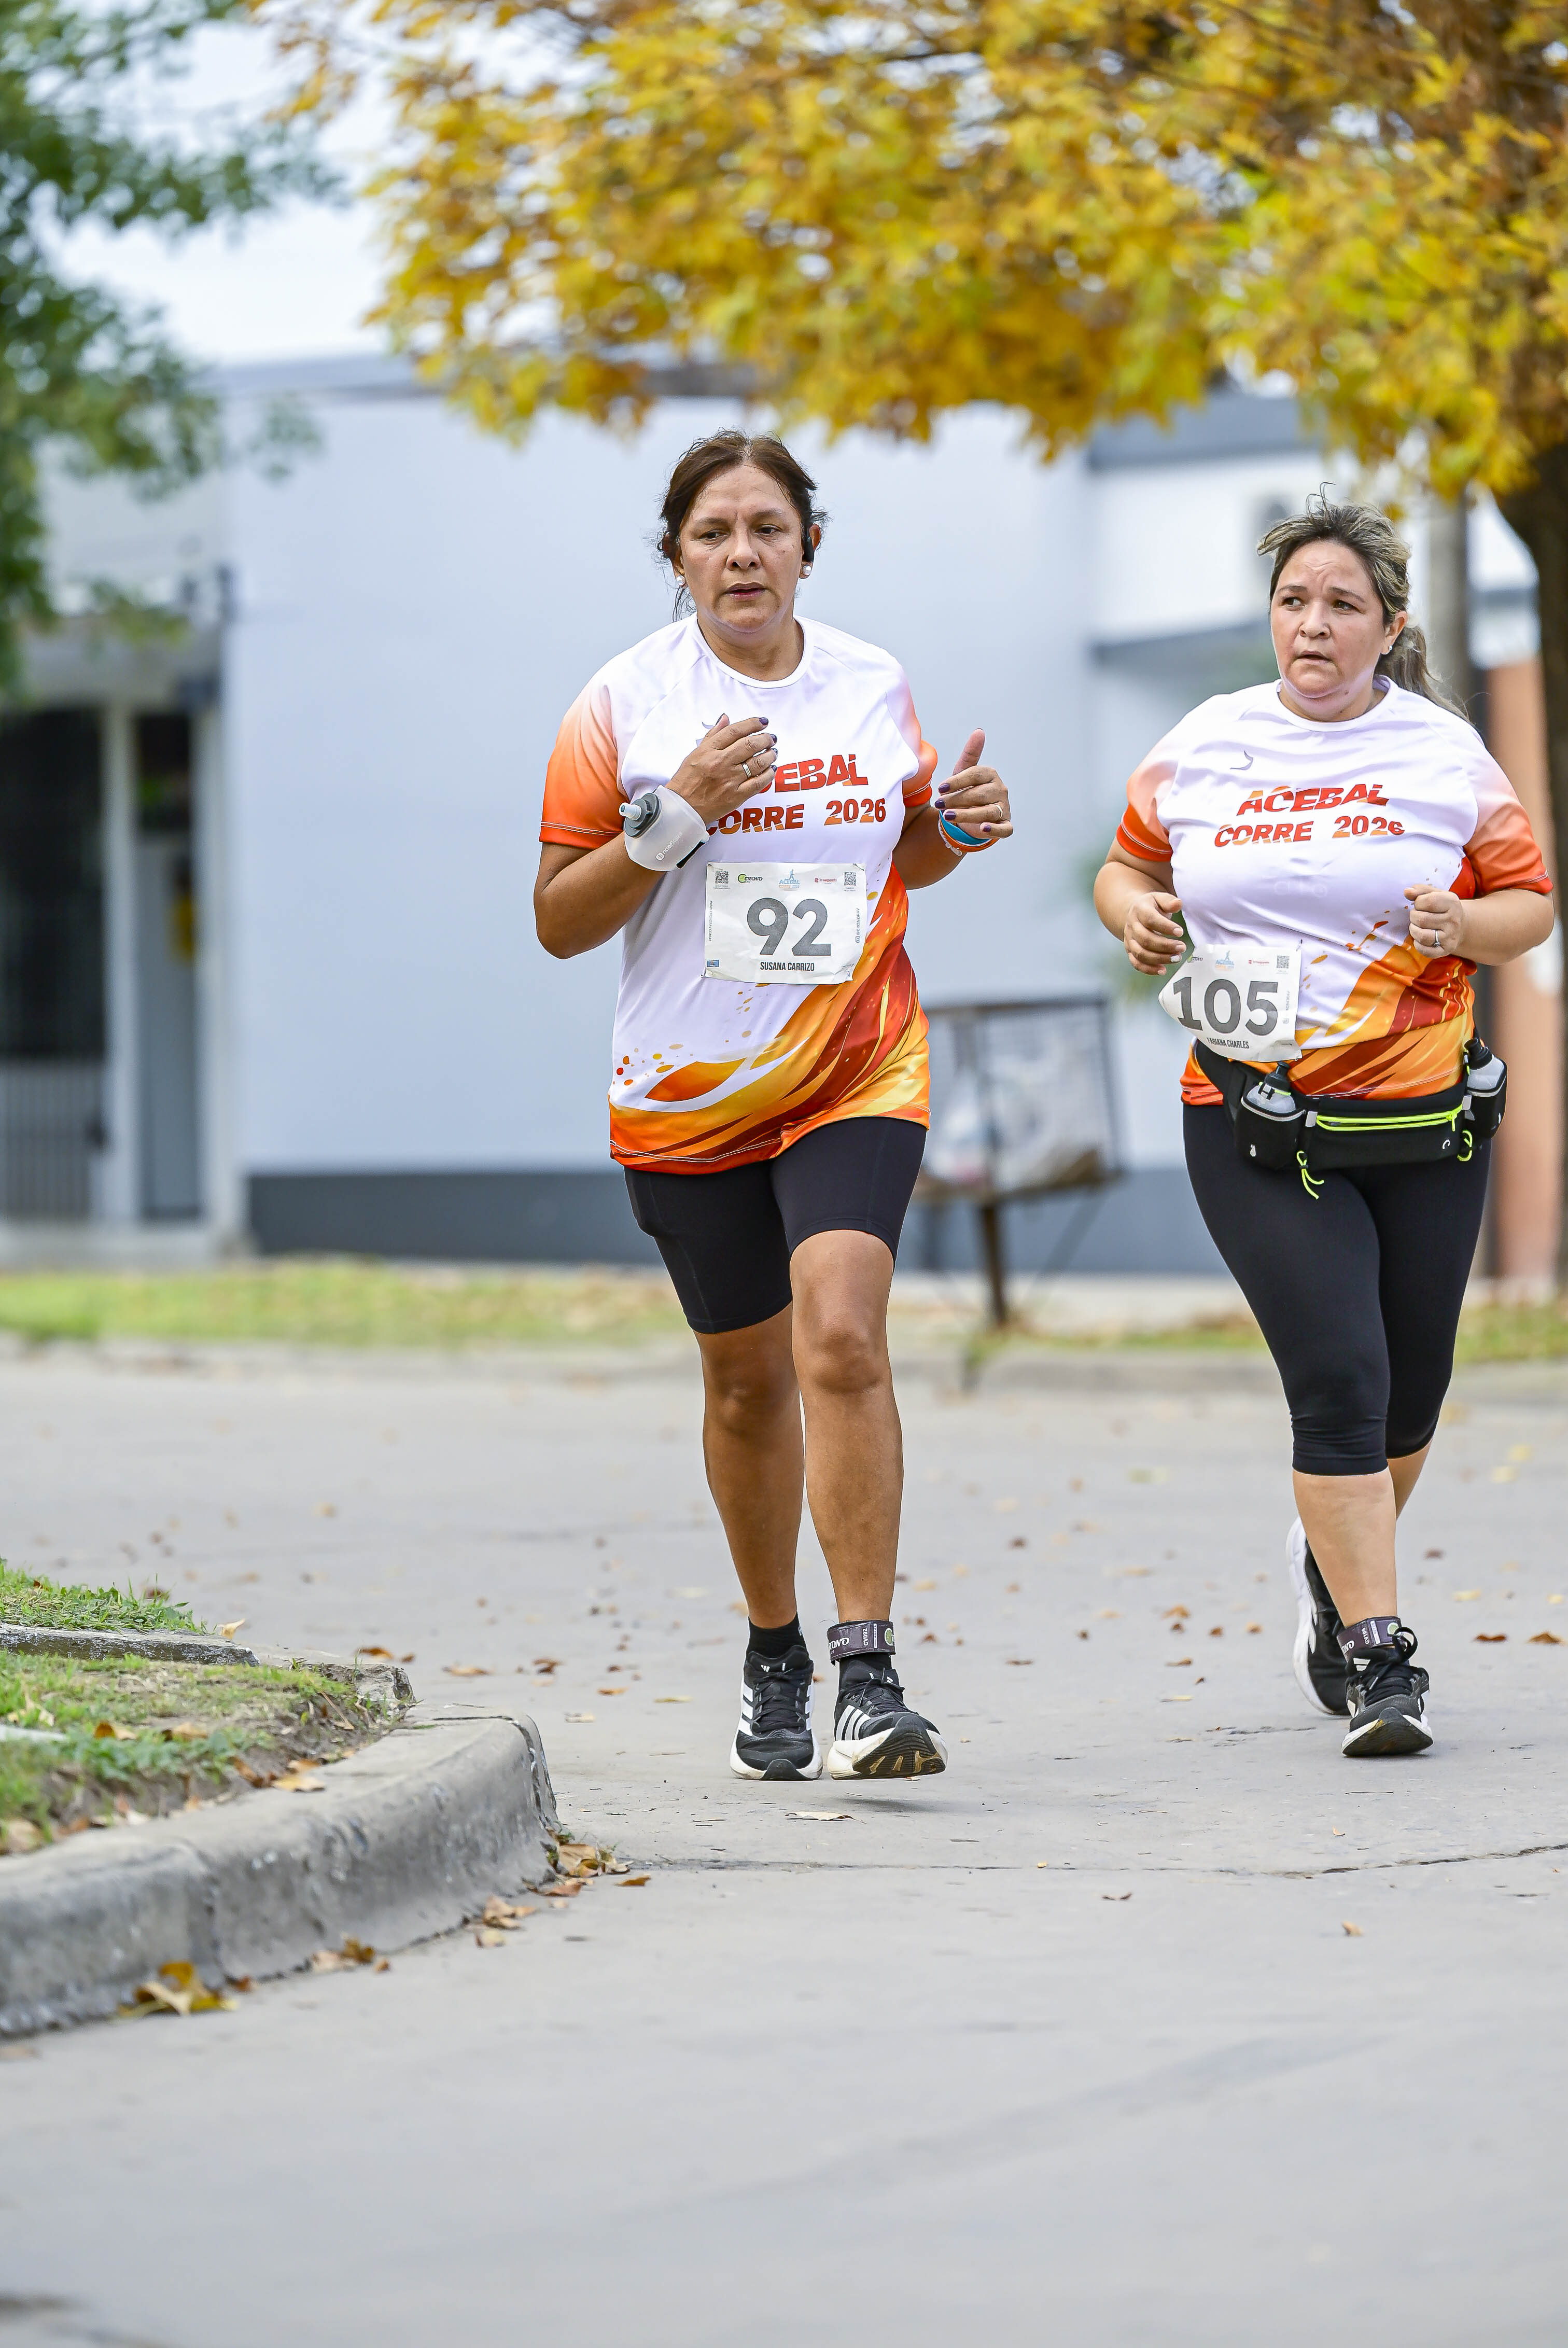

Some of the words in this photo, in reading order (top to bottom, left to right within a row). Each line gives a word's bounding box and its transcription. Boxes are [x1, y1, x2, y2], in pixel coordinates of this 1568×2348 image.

[758, 754, 869, 794] EBAL
[823, 798, 886, 826] 2026
[1236, 784, 1390, 816] ACEBAL
[1214, 821, 1314, 847] CORRE
[747, 898, 831, 956] 92
[760, 962, 786, 971] SUSANA
[788, 962, 815, 971] CARRIZO
[1173, 976, 1278, 1036] 105
[1207, 1037, 1227, 1046] FABIANA
[1227, 1040, 1249, 1049] CHARLES
